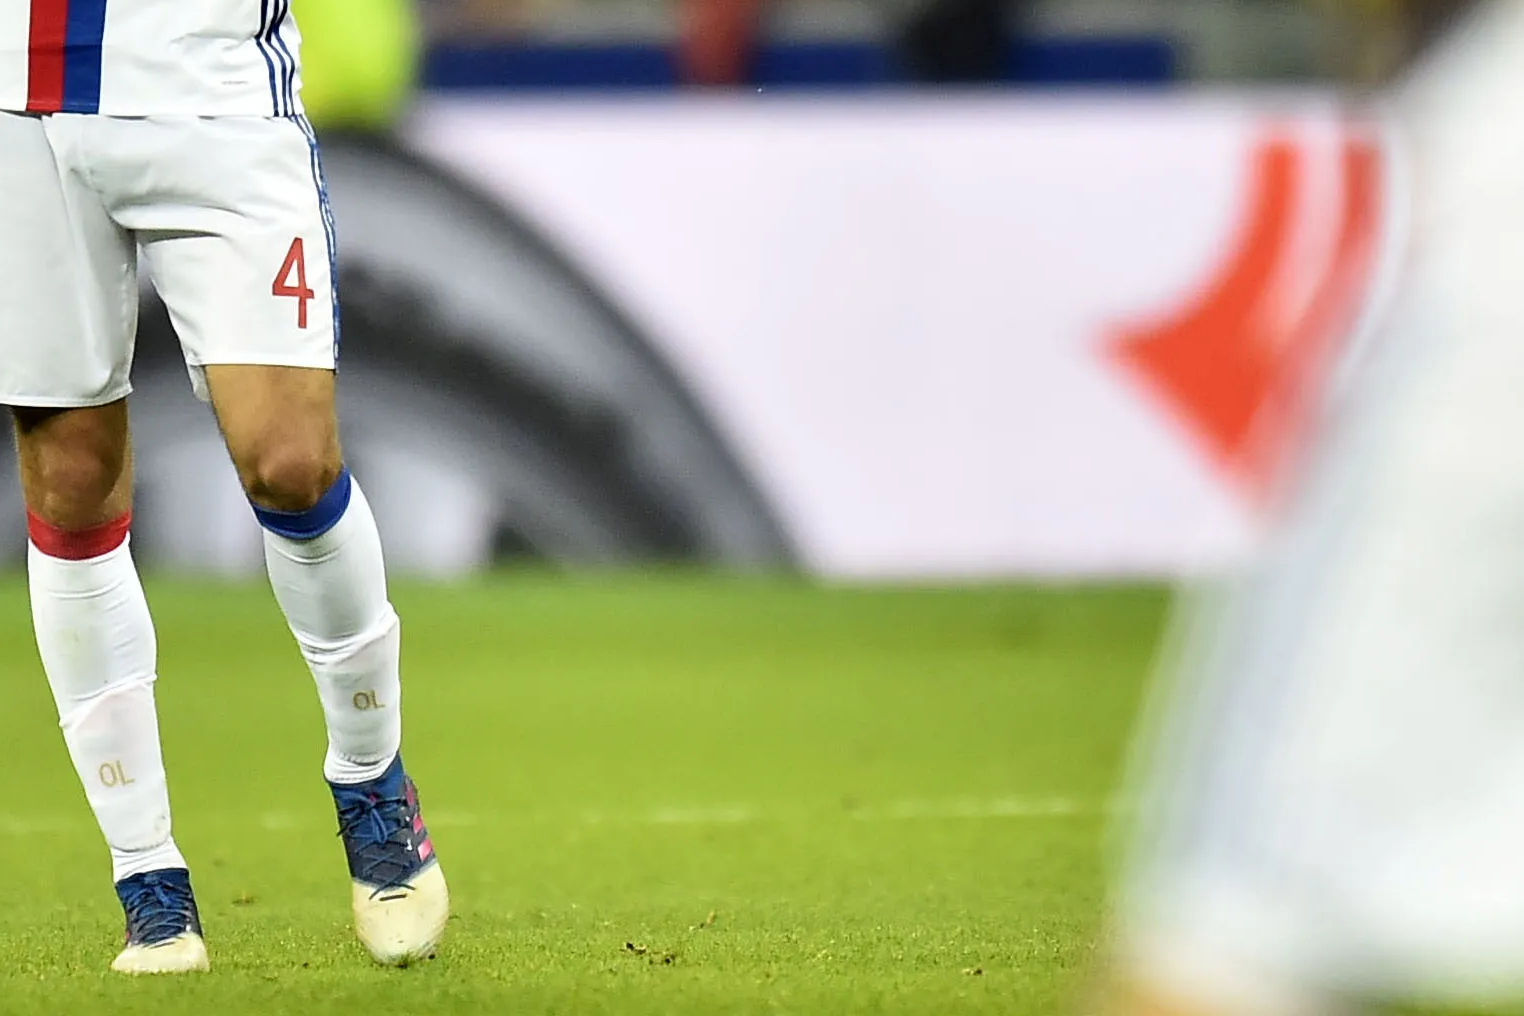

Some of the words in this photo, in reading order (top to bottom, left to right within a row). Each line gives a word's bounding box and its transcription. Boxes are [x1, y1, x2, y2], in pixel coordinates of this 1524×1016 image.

[272, 237, 315, 329] 4
[352, 690, 386, 710] OL
[99, 760, 135, 787] OL
